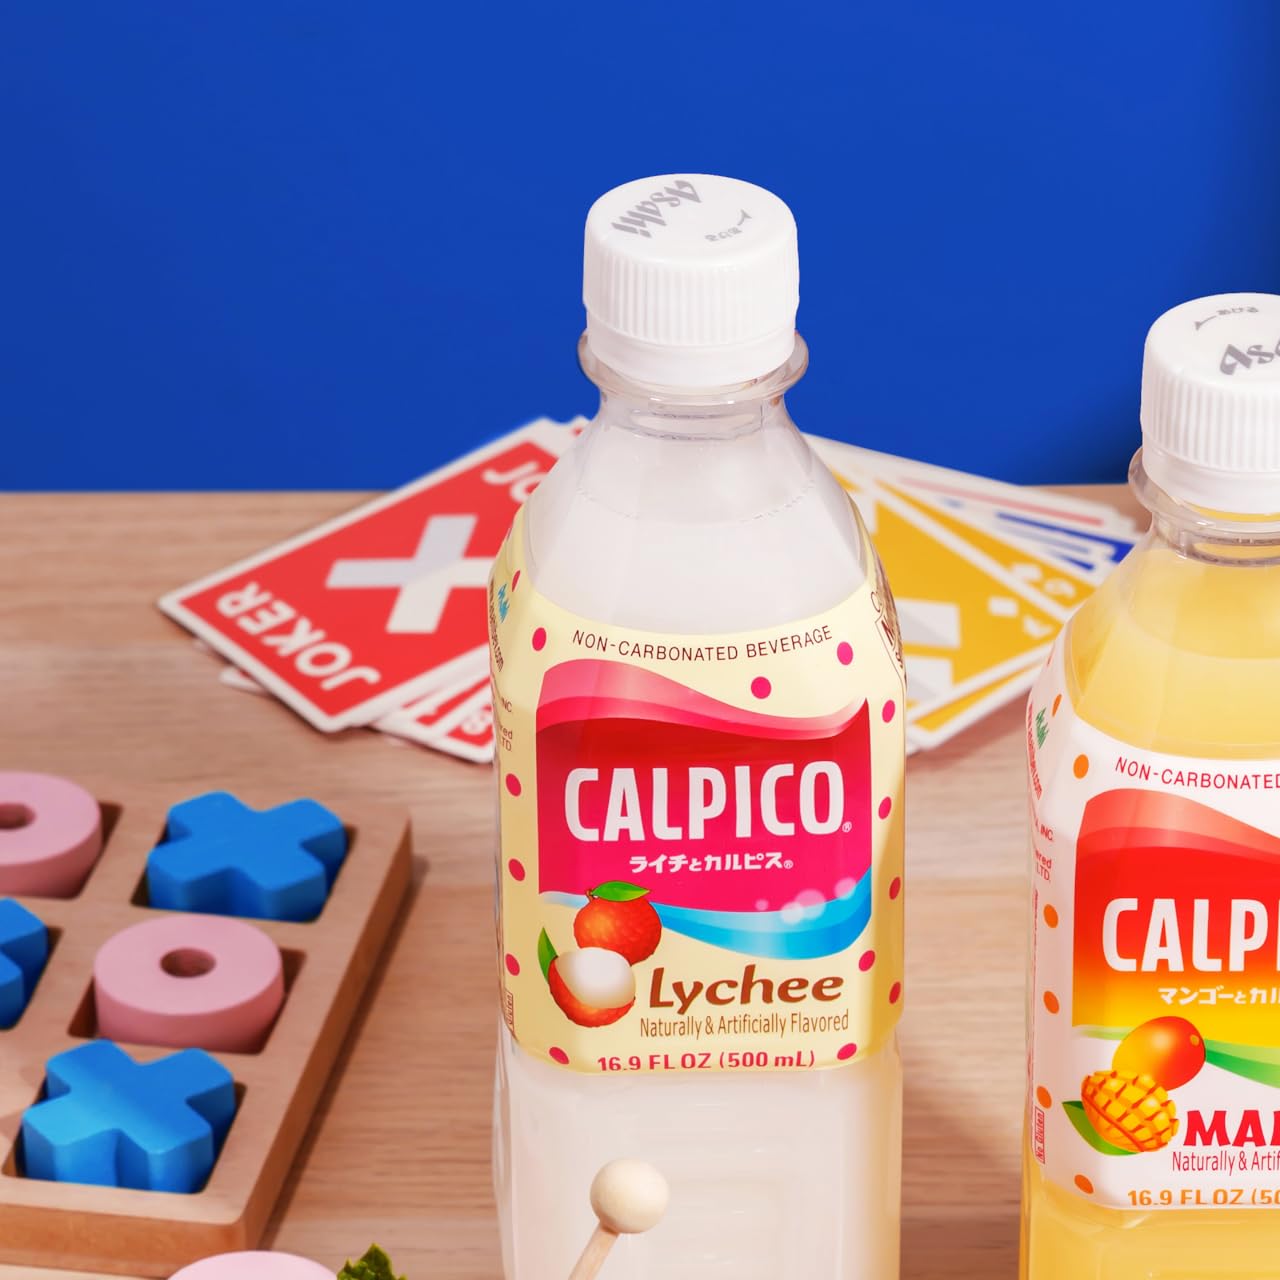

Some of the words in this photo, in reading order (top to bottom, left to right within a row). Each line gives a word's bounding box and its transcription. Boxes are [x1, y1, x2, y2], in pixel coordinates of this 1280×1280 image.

[611, 180, 702, 238] Asahi
[215, 581, 381, 690] JOKER
[572, 629, 738, 662] NON-CARBONATED
[746, 625, 833, 658] BEVERAGE
[649, 963, 845, 1015] Lychee
[640, 1015, 703, 1040] Naturally
[705, 1017, 715, 1035] &
[718, 1011, 787, 1038] Artificially
[791, 1008, 849, 1033] Flavored
[597, 1055, 641, 1071] 16.9
[649, 1054, 675, 1070] FL
[681, 1052, 712, 1069] OZ
[719, 1051, 768, 1069] (500
[774, 1050, 815, 1068] mL)
[1172, 1151, 1233, 1176] Naturally
[1238, 1151, 1248, 1171] &
[1127, 1189, 1172, 1206] 16.9
[1180, 1189, 1206, 1205] FL
[1213, 1188, 1245, 1205] OZ
